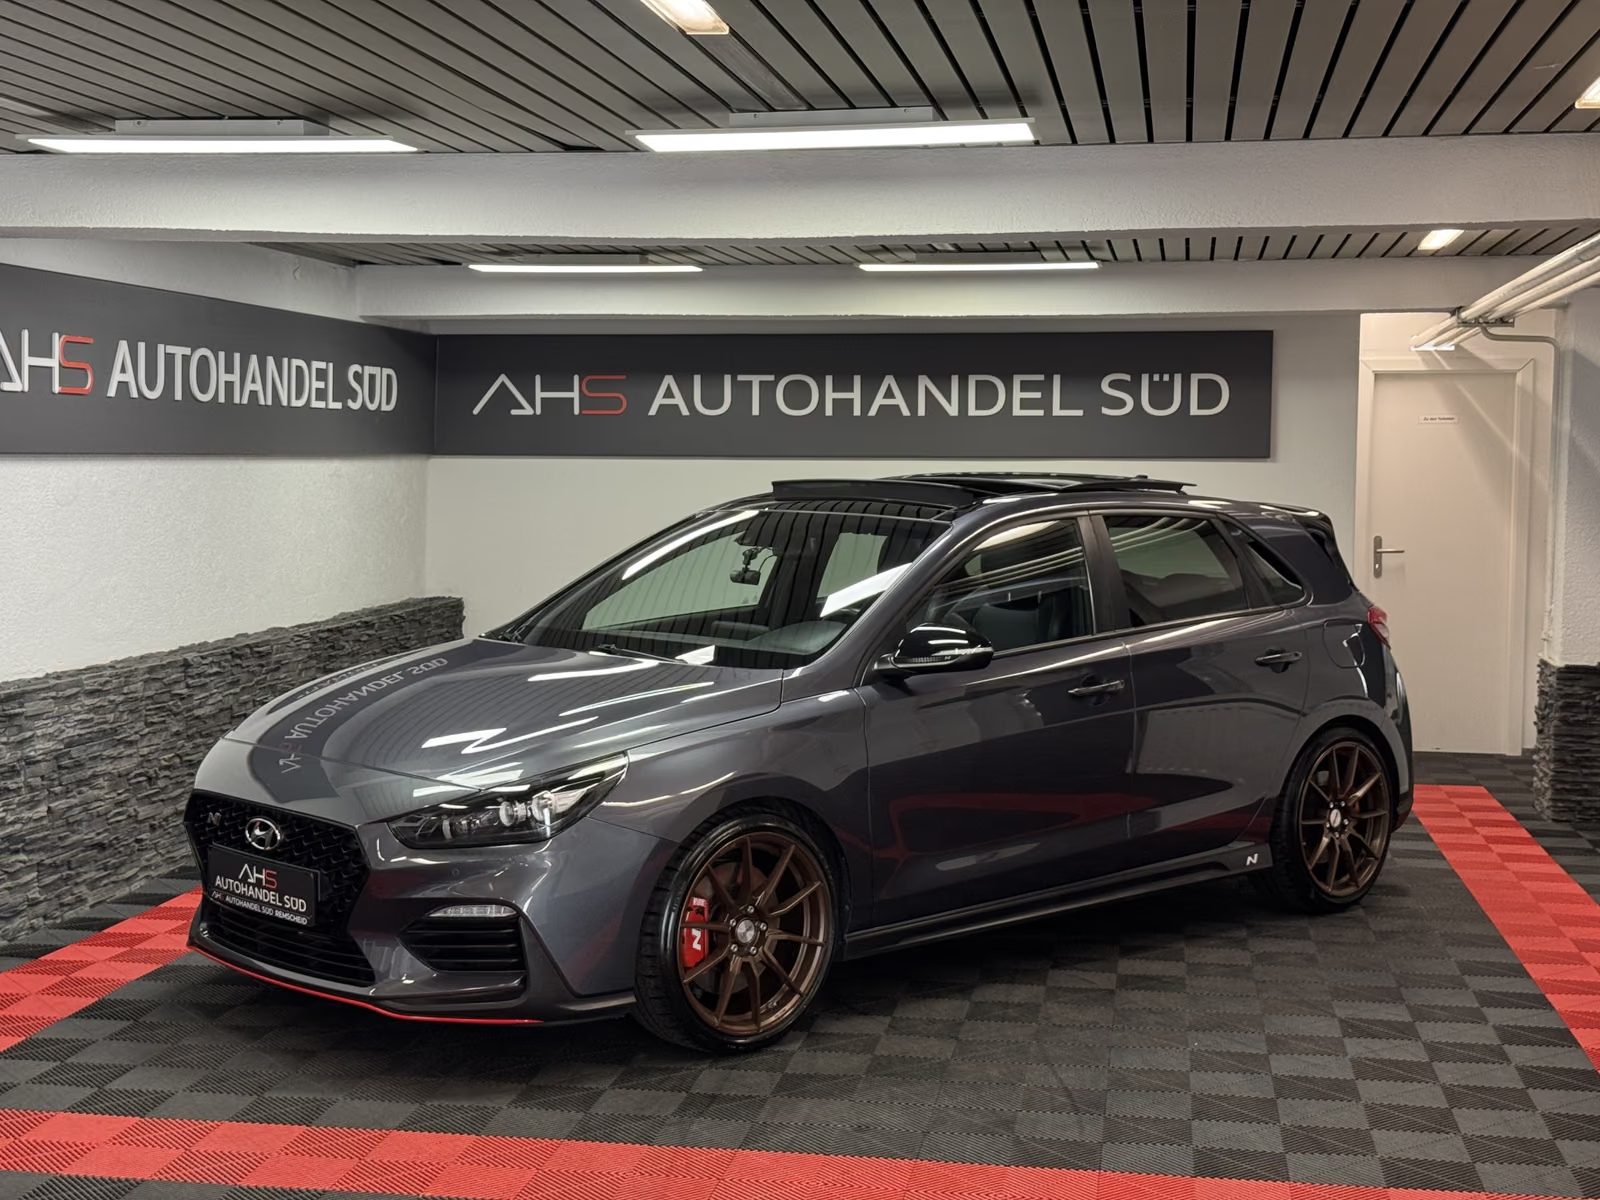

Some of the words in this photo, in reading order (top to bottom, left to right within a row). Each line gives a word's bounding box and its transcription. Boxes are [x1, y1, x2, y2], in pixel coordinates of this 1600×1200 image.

[106, 339, 343, 410] AUTOHANDEL
[347, 363, 399, 412] SÜD
[472, 373, 629, 416] AHS
[647, 374, 1084, 417] AUTOHANDEL
[1100, 372, 1230, 416] SÜD
[238, 863, 278, 889] AHS
[1246, 853, 1258, 866] N
[215, 875, 282, 906] AUTOHANDEL
[284, 895, 307, 912] SÜD
[225, 895, 261, 913] AUTOHANDEL
[275, 910, 308, 925] REMSCHEID
